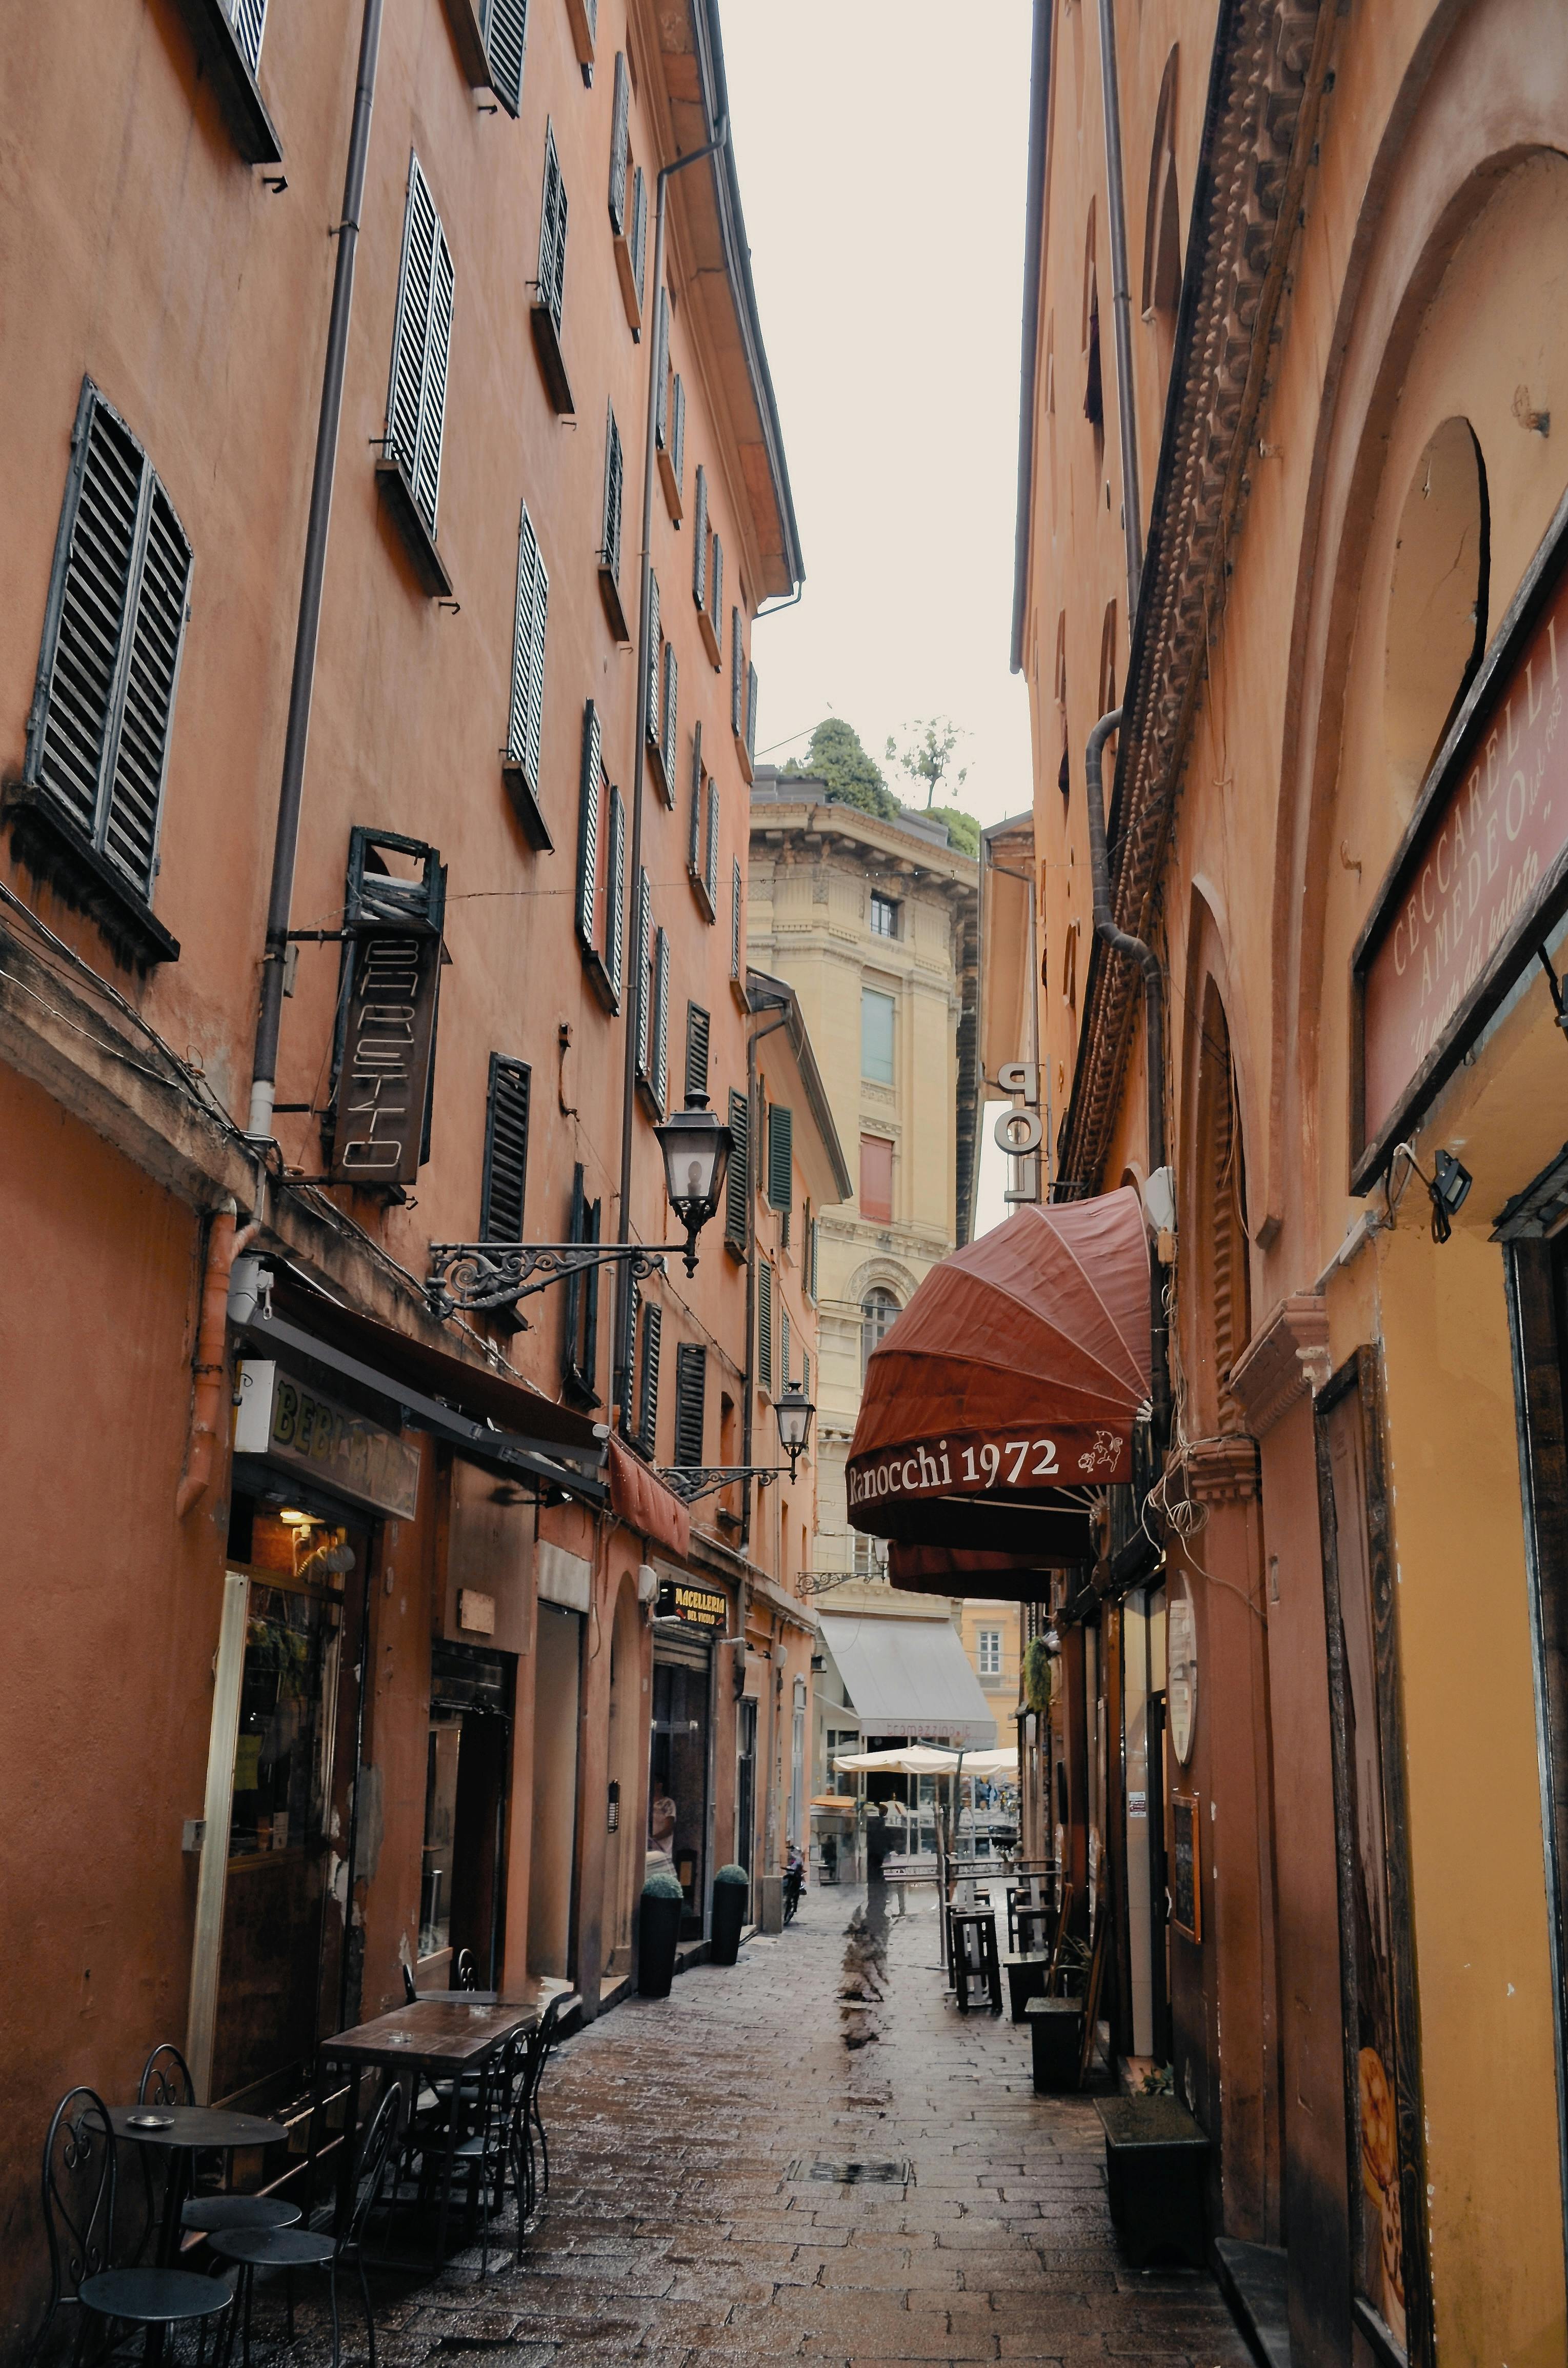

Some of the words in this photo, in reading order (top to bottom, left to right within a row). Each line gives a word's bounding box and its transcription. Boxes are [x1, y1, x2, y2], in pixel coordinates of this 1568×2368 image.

[1393, 615, 1560, 976] CECCARELLI
[1420, 770, 1525, 1008] AMEDEO
[1464, 915, 1483, 996] del
[343, 940, 419, 1168] BARETTO
[849, 1439, 953, 1506] Ranocchi
[961, 1439, 1060, 1489] 1972
[675, 1588, 725, 1613] MACELLERIA
[687, 1610, 697, 1621] DEL
[887, 1722, 972, 1737] tramezzino.it
